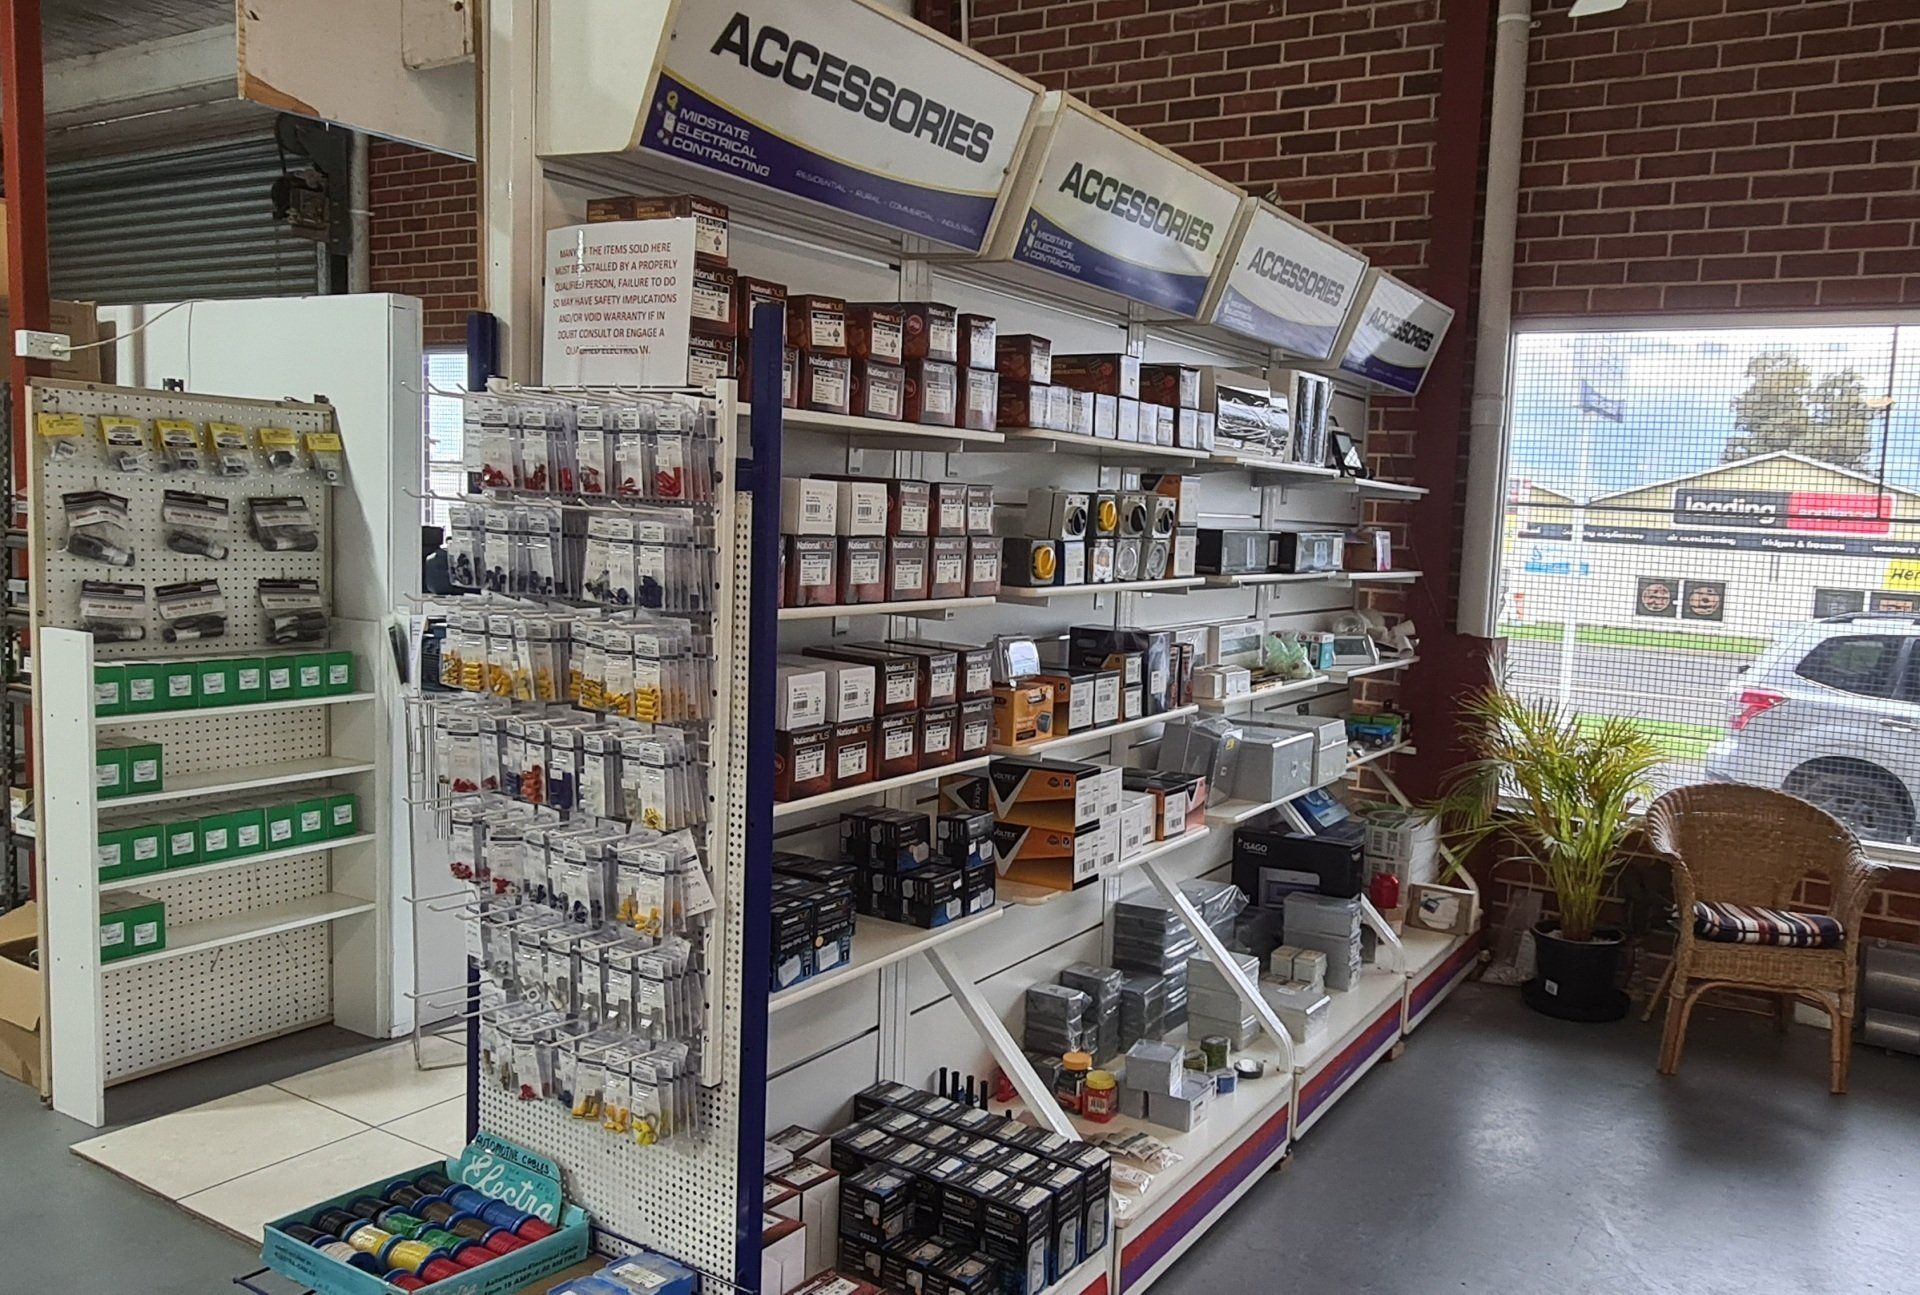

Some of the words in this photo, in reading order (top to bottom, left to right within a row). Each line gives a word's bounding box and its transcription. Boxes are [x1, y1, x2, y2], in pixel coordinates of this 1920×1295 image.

[709, 11, 994, 163] ACCESSORIES
[679, 107, 750, 141] MIDSTATE
[675, 121, 758, 158] ELECTRICAL
[671, 136, 771, 177] CONTRACTING
[1058, 161, 1214, 252] ACCESSORIES
[1036, 229, 1074, 250] MIDSTATE
[559, 248, 577, 258] MANY
[589, 245, 603, 256] THE
[603, 244, 628, 255] ITEMS
[629, 243, 650, 254] SOLD
[650, 242, 671, 253] HERE
[1033, 240, 1076, 261] ELECTRICAL
[554, 265, 570, 275] MUST
[580, 262, 618, 273] NSTALLED
[619, 261, 630, 271] BY
[631, 261, 638, 270] A
[638, 259, 678, 271] PROPERLY
[1029, 251, 1082, 274] CONTRACTING
[585, 278, 617, 290] PERSON,
[617, 277, 649, 288] FAILURE
[651, 276, 663, 287] TO
[663, 276, 676, 287] DO
[694, 268, 715, 281] tional
[1247, 246, 1345, 307] ACCESSORIES
[552, 298, 561, 309] SO
[561, 297, 574, 308] MAY
[574, 296, 593, 307] HAVE
[594, 295, 621, 306] SAFETY
[622, 293, 678, 305] IMPLICATIONS
[558, 312, 583, 324] AND/OR
[584, 312, 602, 323] VOID
[603, 311, 647, 322] WARRANTY
[647, 311, 655, 321] IF
[656, 310, 666, 320] IN
[557, 329, 578, 340] DOUBT
[578, 328, 611, 339] CONSULT
[613, 328, 625, 338] OR
[626, 327, 658, 338] ENGAGE
[658, 327, 665, 337] A
[1365, 306, 1434, 352] ACCESSORIES
[688, 336, 715, 349] ational
[793, 733, 817, 746] National
[836, 724, 859, 738] National
[521, 1155, 550, 1175] CABLES
[462, 1154, 554, 1223] Electra
